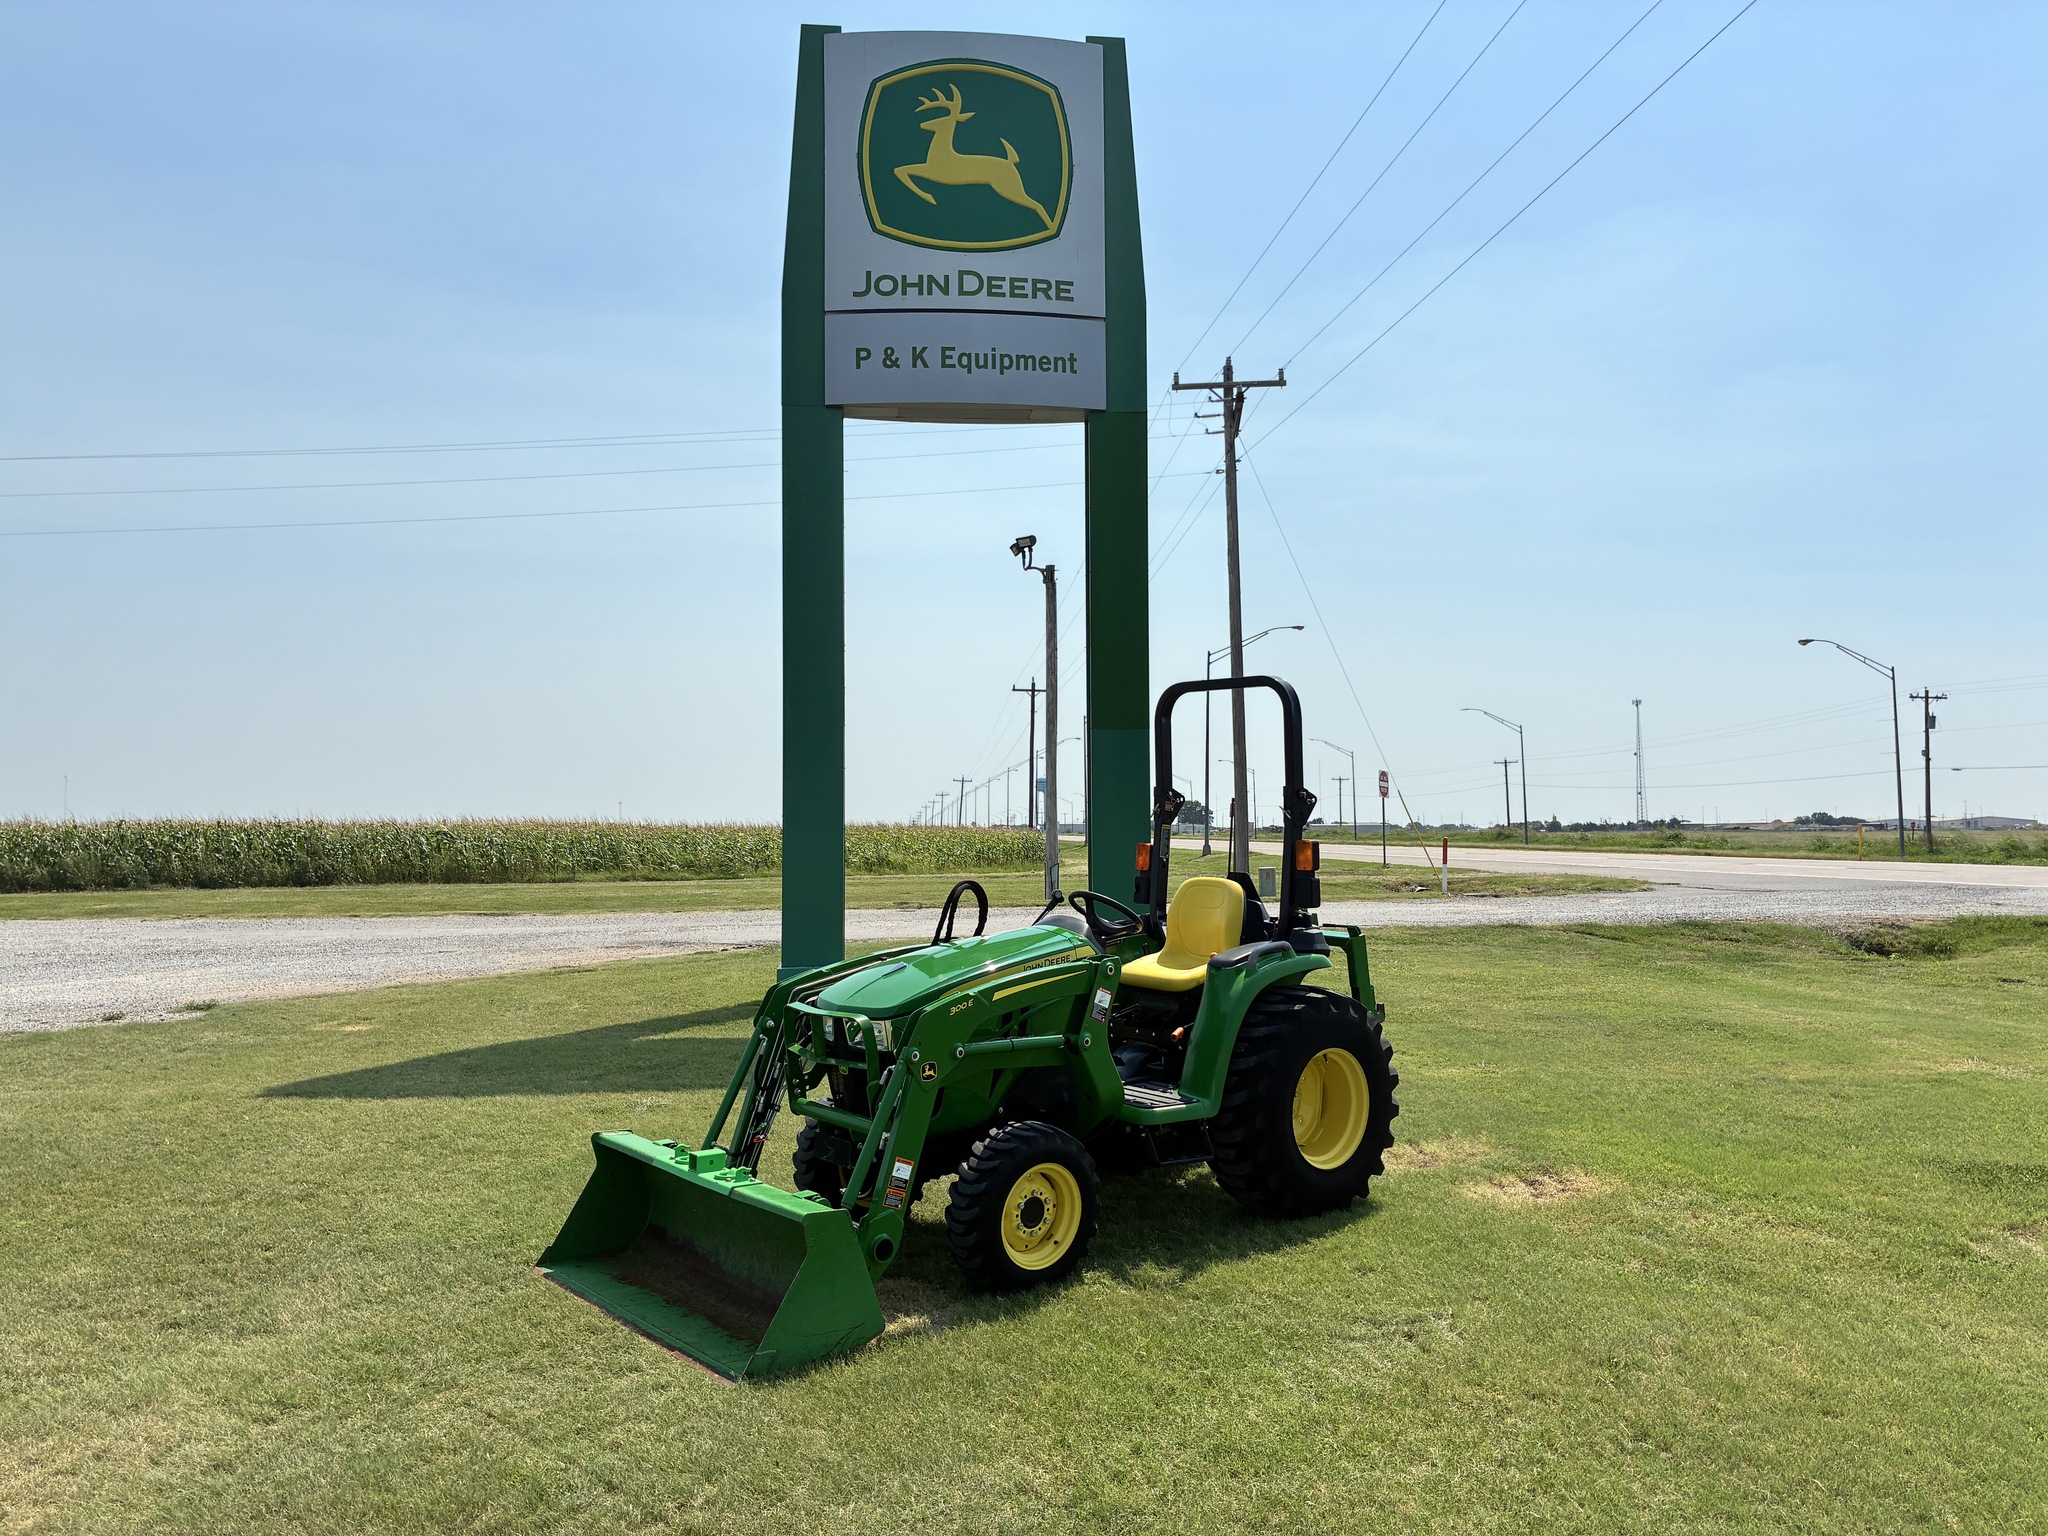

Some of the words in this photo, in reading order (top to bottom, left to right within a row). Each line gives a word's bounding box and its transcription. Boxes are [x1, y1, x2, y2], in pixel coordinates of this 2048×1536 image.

[853, 270, 949, 298] JOHN
[957, 270, 1075, 302] DEERE
[855, 347, 872, 370] P
[882, 346, 900, 369] &
[911, 346, 929, 369] K
[940, 346, 1078, 376] Equipment
[1044, 954, 1071, 968] DEERE
[949, 1001, 968, 1016] 300
